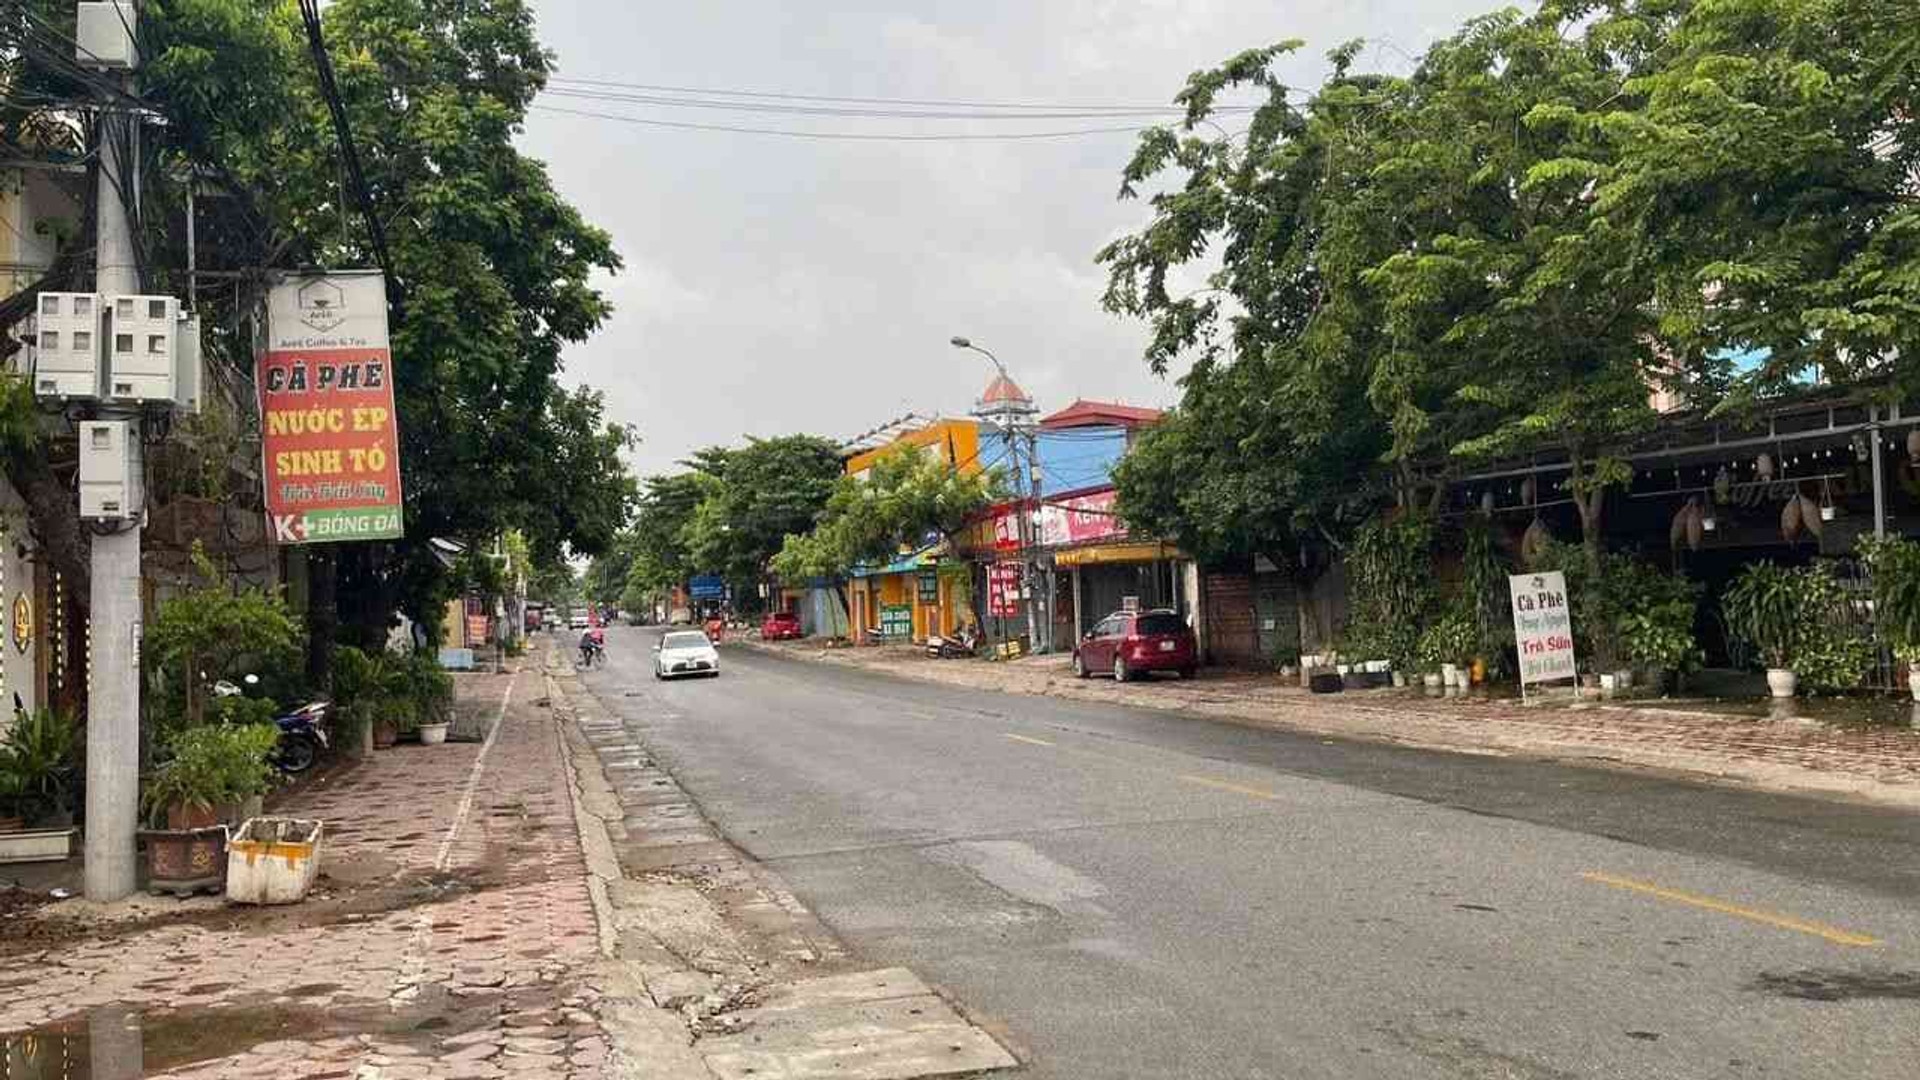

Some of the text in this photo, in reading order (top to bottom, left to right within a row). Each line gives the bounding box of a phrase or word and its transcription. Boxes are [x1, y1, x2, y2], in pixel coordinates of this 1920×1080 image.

[317, 358, 384, 389] PHÊ
[266, 402, 388, 435] NƯỚC ÉP
[276, 439, 386, 476] SINH TỐ
[274, 515, 315, 541] K+
[317, 513, 369, 534] BÓNG
[1517, 591, 1563, 611] Cà Phê
